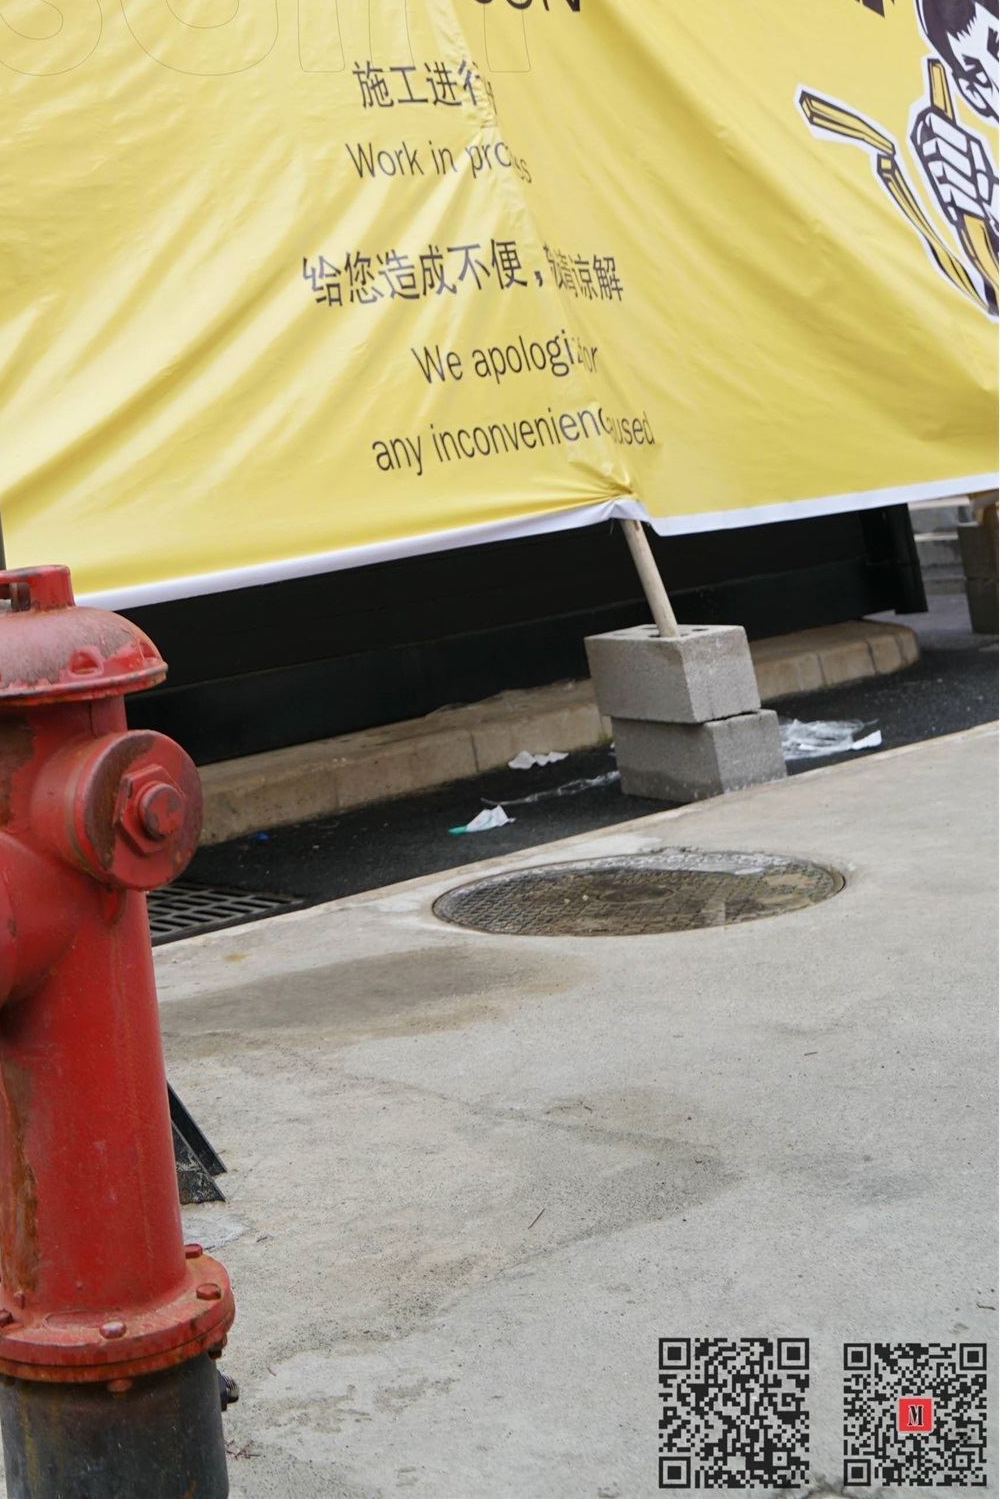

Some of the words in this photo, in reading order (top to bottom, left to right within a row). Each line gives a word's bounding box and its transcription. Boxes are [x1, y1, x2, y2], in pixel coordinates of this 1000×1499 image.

[345, 140, 425, 179] Work
[428, 140, 458, 176] in
[411, 344, 464, 384] We
[371, 434, 423, 477] any
